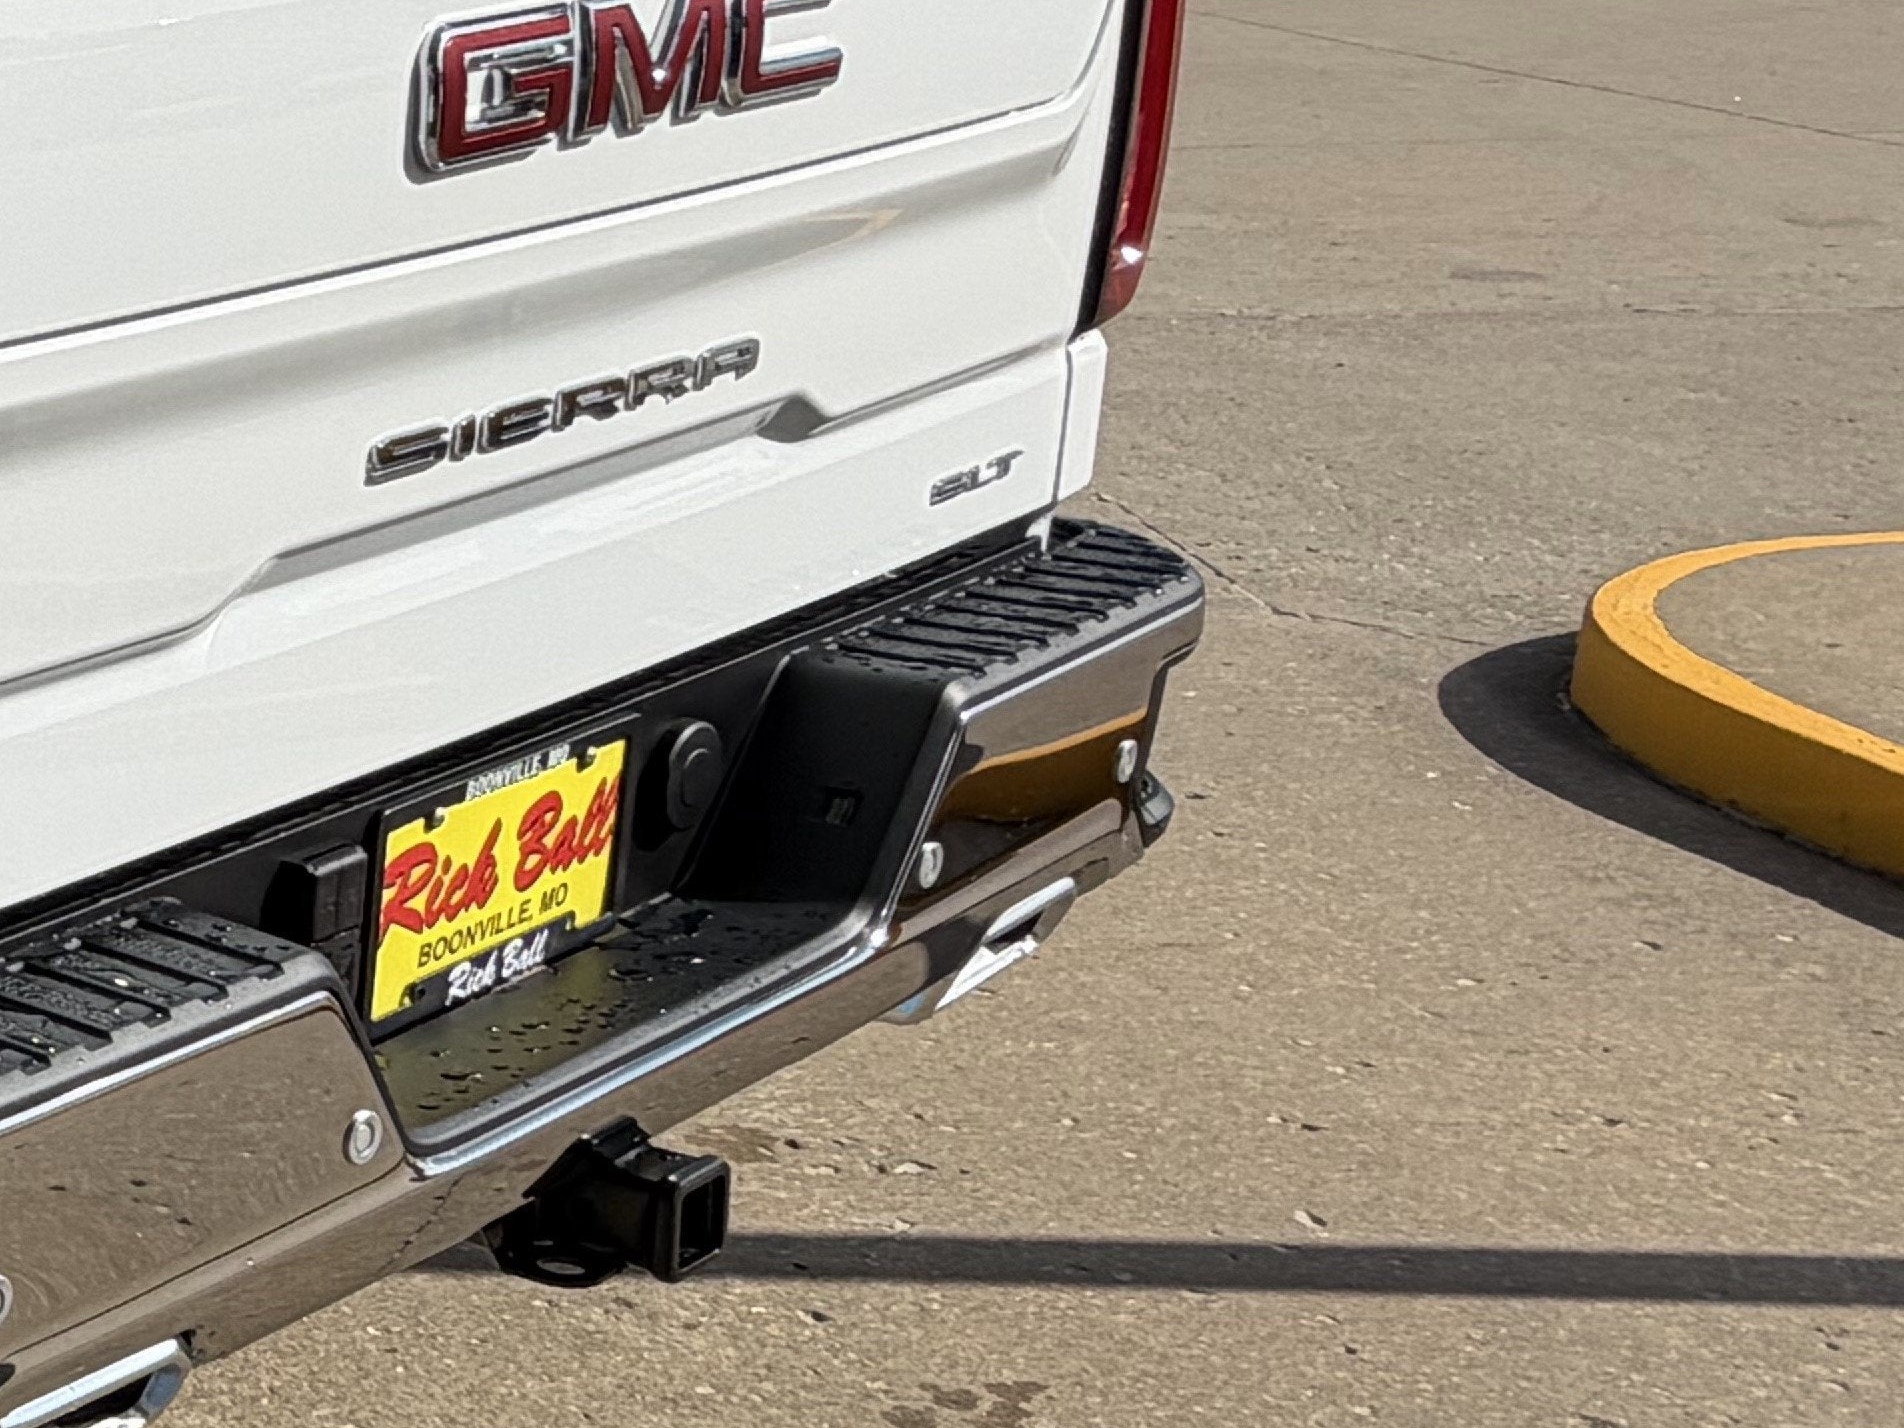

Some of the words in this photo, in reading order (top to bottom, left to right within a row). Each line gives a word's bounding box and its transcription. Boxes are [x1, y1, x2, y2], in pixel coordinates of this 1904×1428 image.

[364, 336, 761, 486] SIERRA
[928, 450, 1024, 507] SLT
[379, 817, 503, 948] Rick
[513, 772, 621, 893] Ball
[539, 882, 569, 915] MO
[445, 950, 498, 1006] Rick
[502, 929, 549, 977] Ball
